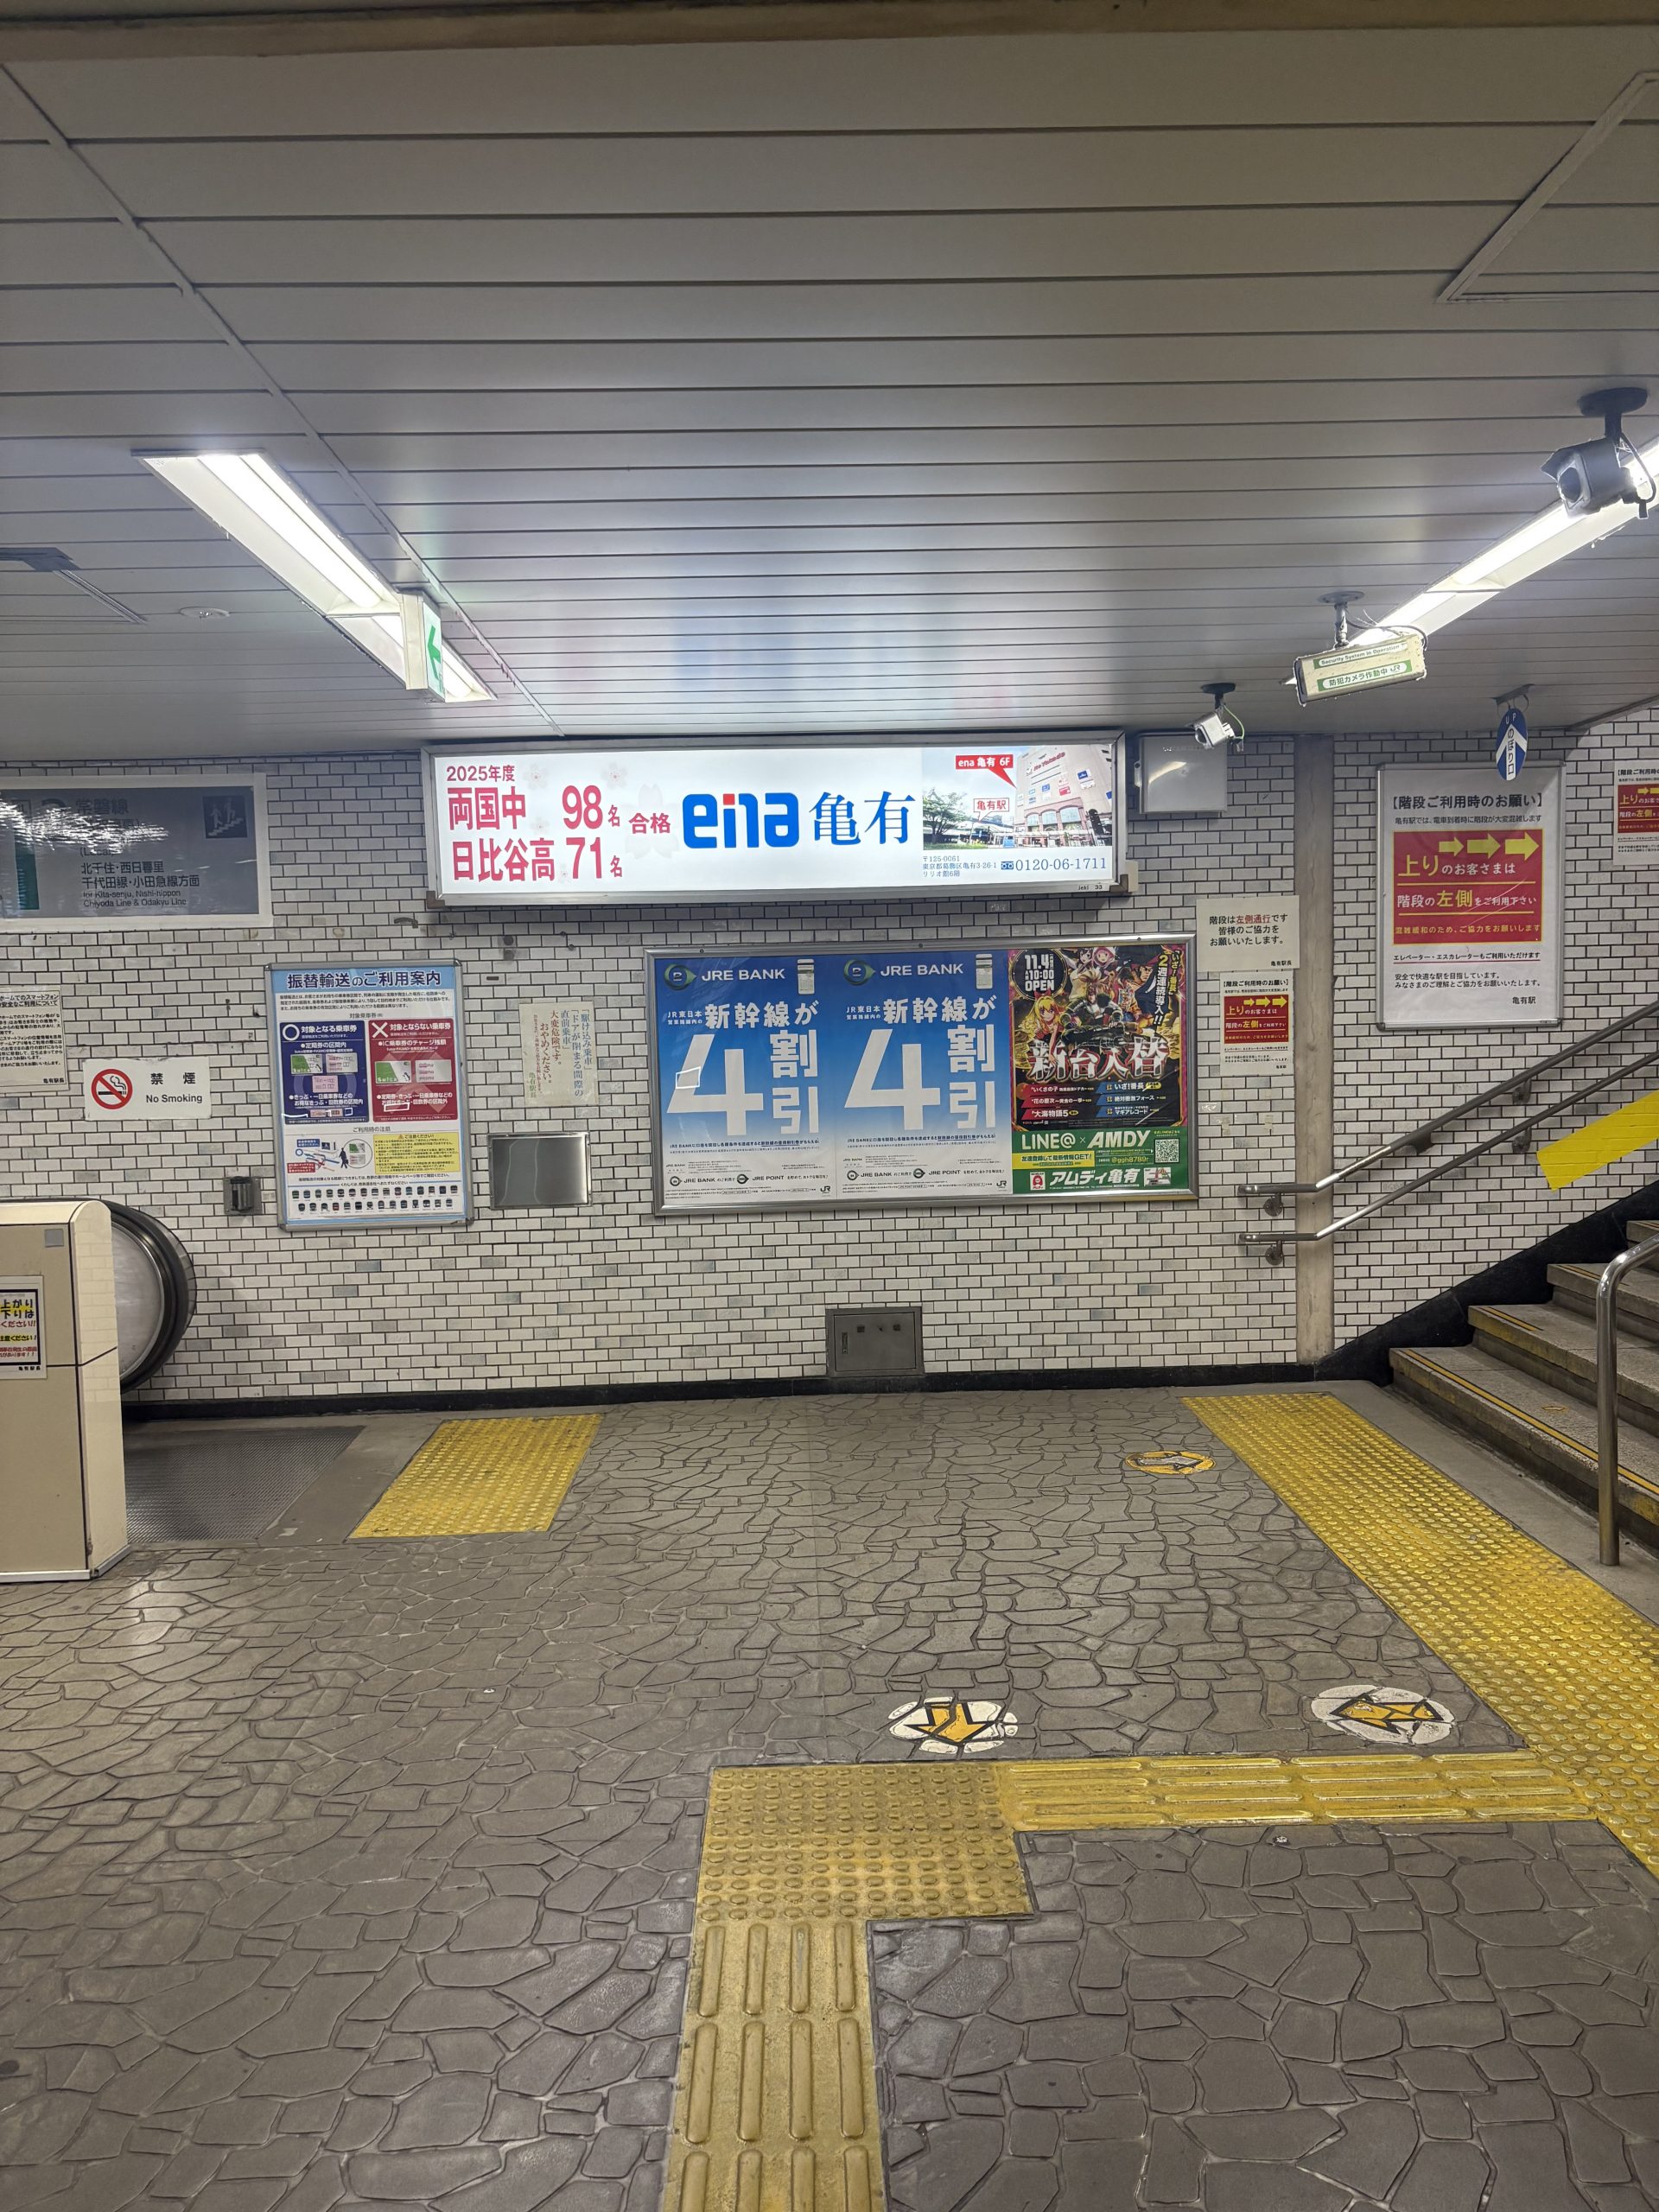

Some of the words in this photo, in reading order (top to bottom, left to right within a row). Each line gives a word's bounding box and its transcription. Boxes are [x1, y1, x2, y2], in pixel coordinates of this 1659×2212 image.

[1321, 657, 1344, 665] Security
[1344, 652, 1365, 662] System
[1329, 668, 1388, 686] 防犯カメラ作動中
[958, 759, 974, 767] ena
[977, 757, 995, 766] 亀有
[1000, 757, 1010, 766] 6F
[447, 765, 515, 782] 2025年度
[448, 785, 527, 830] 両国中
[976, 801, 1007, 810] 亀有駅
[1394, 793, 1542, 810] 【階段ご利用時のお願い】
[629, 812, 671, 835] 合格
[683, 792, 799, 849] ena
[809, 791, 916, 845] 亀有
[81, 861, 164, 874] 北千住・西日暮里
[452, 837, 555, 881] 日比谷高
[1015, 857, 1106, 871] 0120-06-1711
[1398, 855, 1516, 877] 上りのお客さまは
[82, 875, 200, 889] 千代田線・小田急線方面
[83, 899, 114, 908] Chiyoda
[141, 899, 169, 907] Odakyu
[1397, 889, 1537, 908] 階段の左側をご利用下さい
[1210, 913, 1287, 925] 階段は左側通行です
[1218, 925, 1280, 936] 皆様のご協力を
[1210, 936, 1284, 947] お願いいたします。
[880, 965, 912, 976] JRE
[917, 963, 964, 976] BANK
[1025, 954, 1049, 970] 11.4
[287, 970, 442, 989] 振替輸送のご利用案内
[702, 970, 734, 982] JRE
[739, 969, 785, 981] BANK
[1029, 969, 1054, 980] 10:00
[1025, 980, 1055, 992] OPEN
[1512, 996, 1536, 1005] 亀有駅
[705, 1000, 819, 1029] 新幹線が
[883, 995, 997, 1025] 新幹線が
[1225, 1006, 1277, 1015] 上りのお客さまは
[302, 1025, 358, 1033] 対象となる乗車券
[390, 1022, 451, 1031] 対象とならない乗車券
[550, 1010, 562, 1065] 大変危険です。
[581, 1008, 593, 1071] 「駆け込み乗車」
[540, 1022, 552, 1084] おやめください。
[570, 1009, 584, 1097] 「ドアが閉まる間際の
[1029, 1037, 1169, 1080] 新台入替
[770, 1029, 820, 1135] 割引
[843, 1028, 941, 1130] 4
[947, 1023, 996, 1129] 割引
[666, 1034, 764, 1136] 4
[162, 1094, 203, 1103] Smoking
[1021, 1132, 1076, 1150] LINE@
[1087, 1130, 1151, 1149] AMDY
[1050, 1168, 1141, 1186] アムディ亀有
